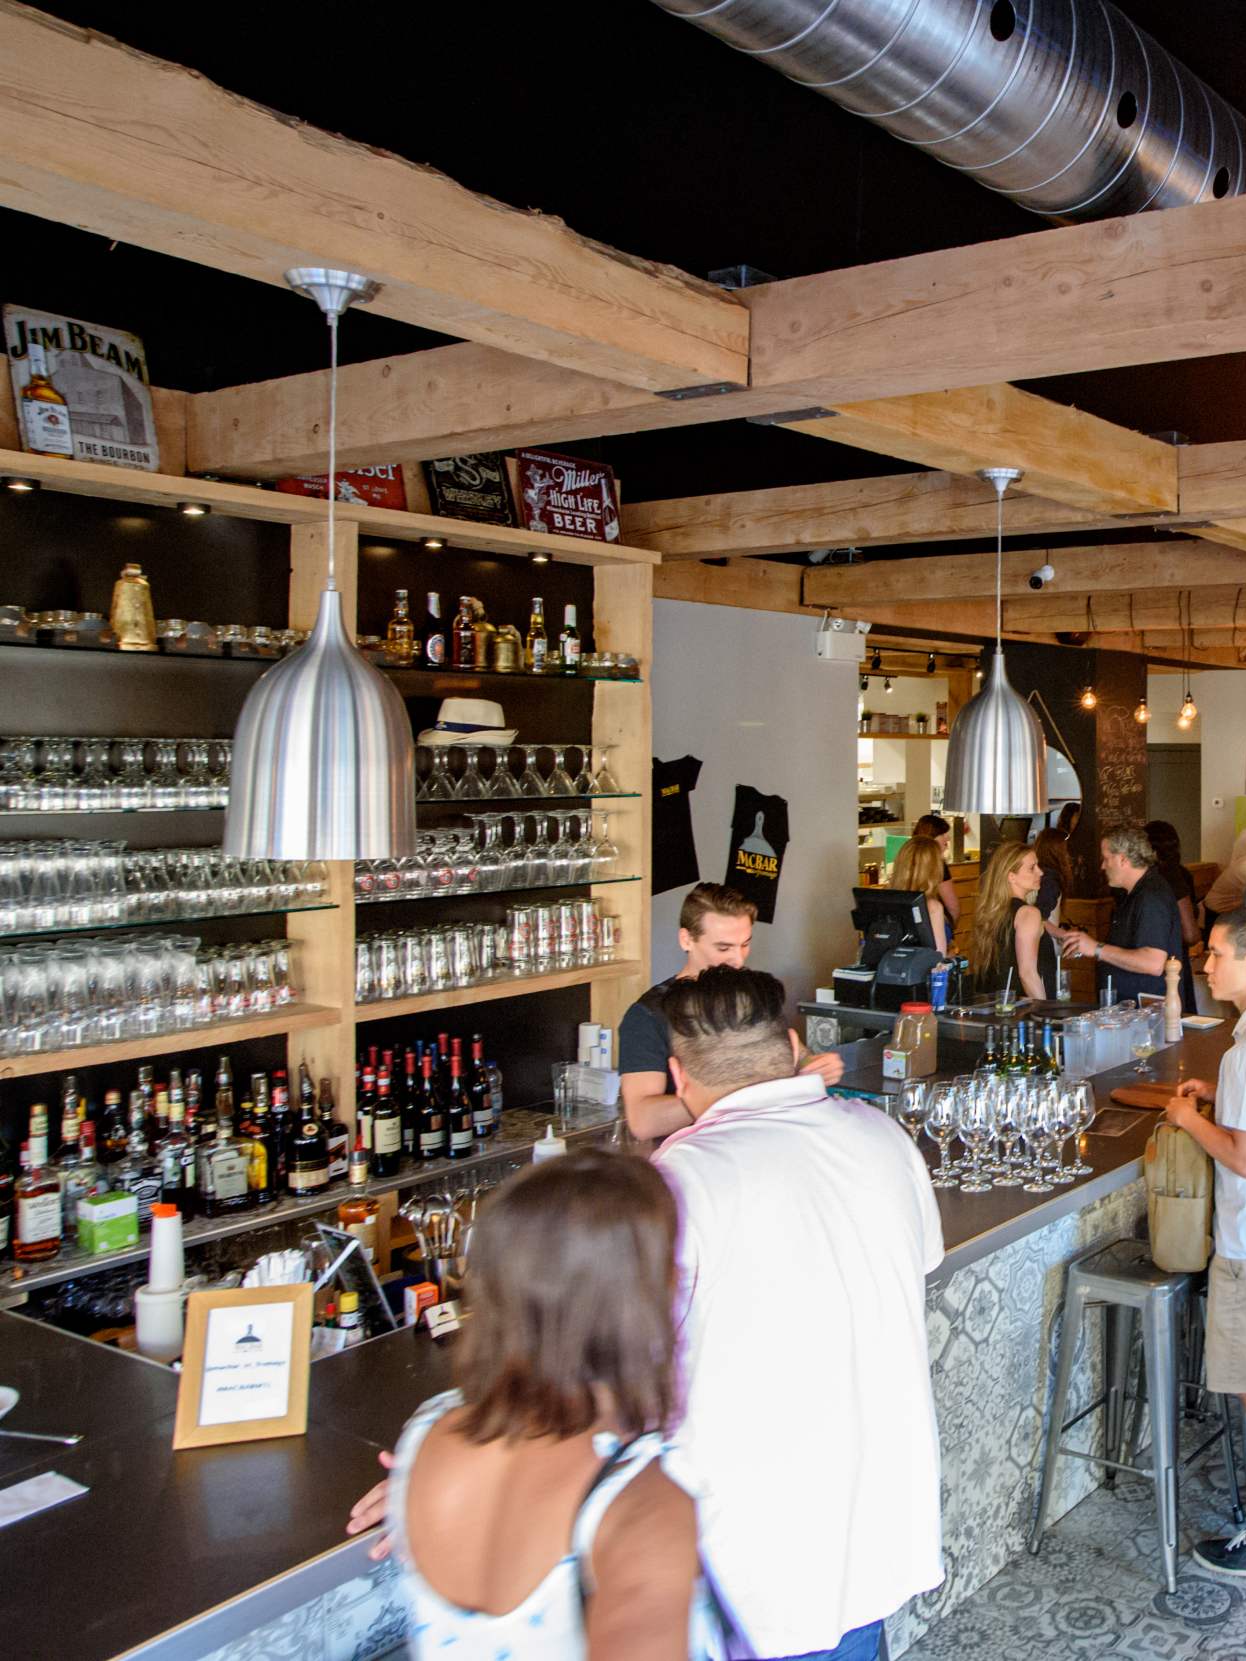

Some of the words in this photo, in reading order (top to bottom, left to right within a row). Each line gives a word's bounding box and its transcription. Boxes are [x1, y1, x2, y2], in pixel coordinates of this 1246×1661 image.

[10, 320, 64, 359] JIM
[67, 321, 147, 384] BEAM
[78, 441, 98, 455] THE
[101, 445, 150, 464] BOURBON
[552, 466, 604, 492] Miller
[549, 488, 575, 509] HIGH
[576, 493, 602, 514] LIFE
[553, 513, 597, 533] BEER
